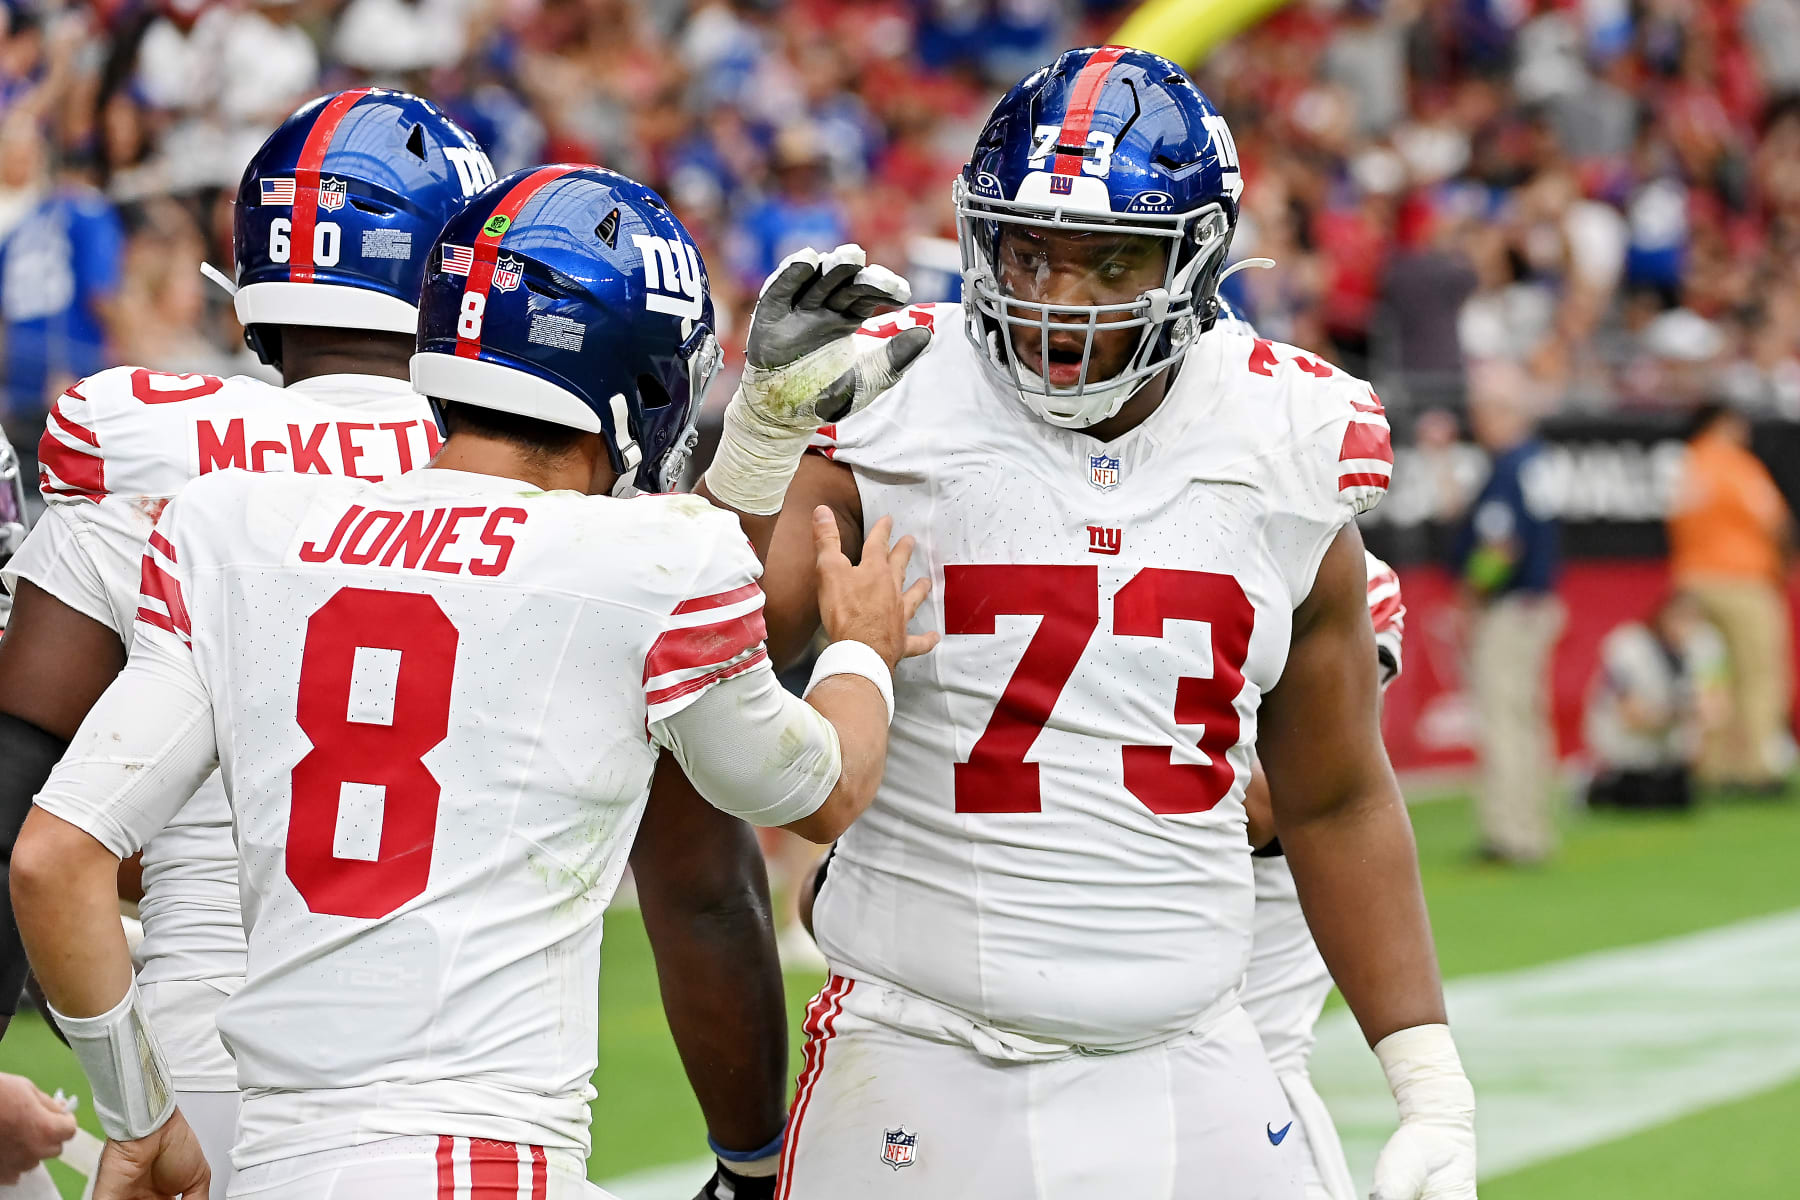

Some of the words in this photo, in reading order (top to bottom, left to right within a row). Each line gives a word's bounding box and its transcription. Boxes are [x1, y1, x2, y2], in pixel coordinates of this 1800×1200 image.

[1027, 125, 1116, 178] 73
[322, 191, 342, 207] NFL
[1132, 204, 1174, 212] OAKLEY
[269, 218, 341, 267] 60
[495, 270, 517, 288] NFL
[631, 234, 702, 321] ny
[457, 290, 486, 340] 8
[1093, 468, 1116, 485] NFL
[300, 504, 528, 577] JONES
[1087, 526, 1121, 556] ny
[944, 565, 1255, 815] 73
[286, 587, 459, 919] 8
[886, 1143, 911, 1162] NFL
